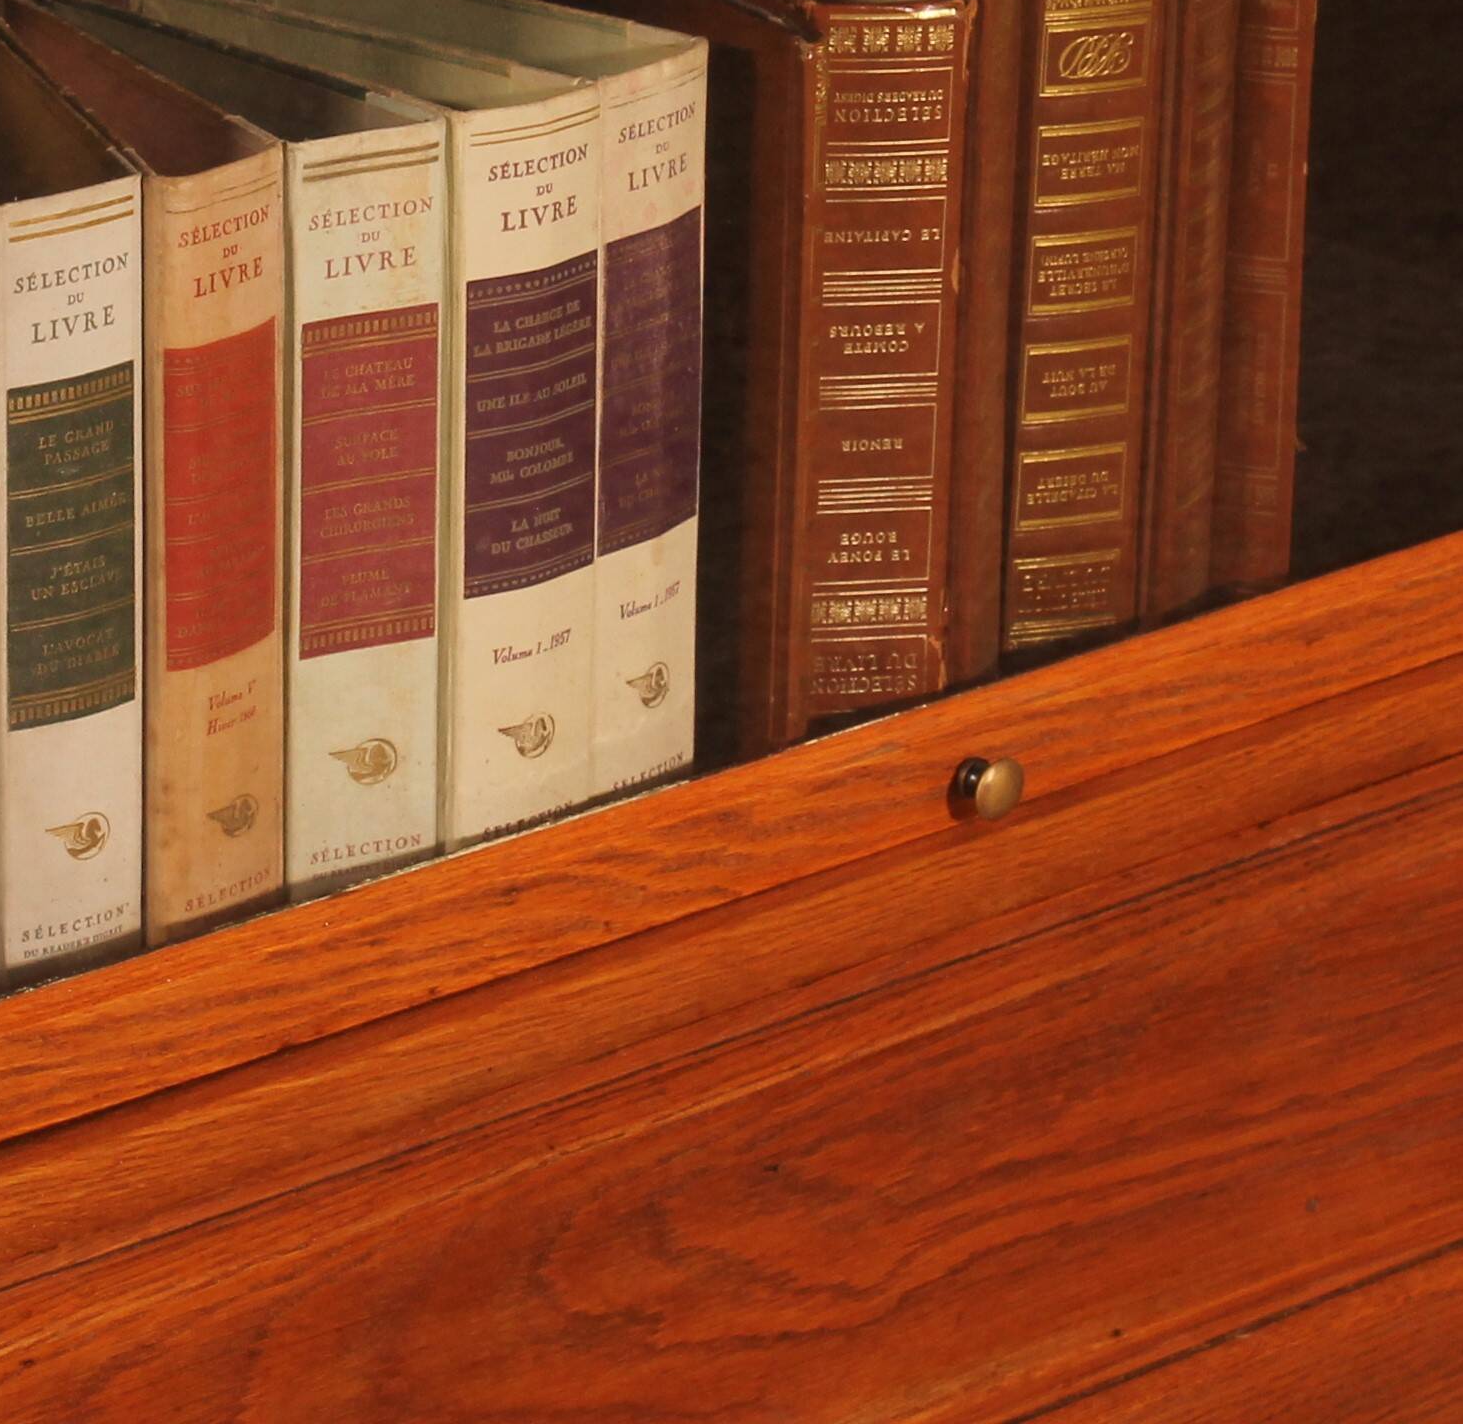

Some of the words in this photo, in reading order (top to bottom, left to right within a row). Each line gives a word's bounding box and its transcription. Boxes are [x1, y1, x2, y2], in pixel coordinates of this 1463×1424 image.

[655, 141, 669, 155] DU
[488, 143, 589, 182] SÉLECTION
[628, 152, 688, 192] LIVRE
[1060, 165, 1102, 180] TERRE
[536, 182, 553, 196] DU
[308, 196, 434, 232] SÉLECTION
[501, 194, 578, 232] LIVRE
[178, 204, 271, 248] SÉLECTION
[361, 230, 381, 243] DU
[824, 228, 912, 244] CAPITAINE
[921, 228, 940, 241] LE
[223, 244, 239, 259] DU
[325, 246, 417, 280] LIVRE
[13, 252, 129, 294] SÉLECTION
[194, 256, 264, 298] LIVRE
[67, 293, 85, 305] DU
[31, 304, 116, 344] LIVRE
[493, 320, 511, 333] LA
[829, 323, 906, 338] REBOURS
[914, 322, 926, 333] A
[843, 340, 909, 354] COMPTE
[38, 434, 58, 450] LE
[64, 420, 114, 446] GRAND
[842, 438, 904, 452] RENOIR
[44, 440, 111, 466] PASSAGE
[25, 508, 75, 527] BELLE
[510, 518, 529, 533] LA
[840, 531, 898, 546] ROUGE
[491, 540, 511, 555] DU
[891, 549, 911, 561] LE
[827, 550, 883, 564] PONEY
[30, 586, 54, 601] UN
[620, 601, 651, 620] Volume
[492, 646, 533, 665] Volume
[309, 834, 422, 865] SÉLECTION
